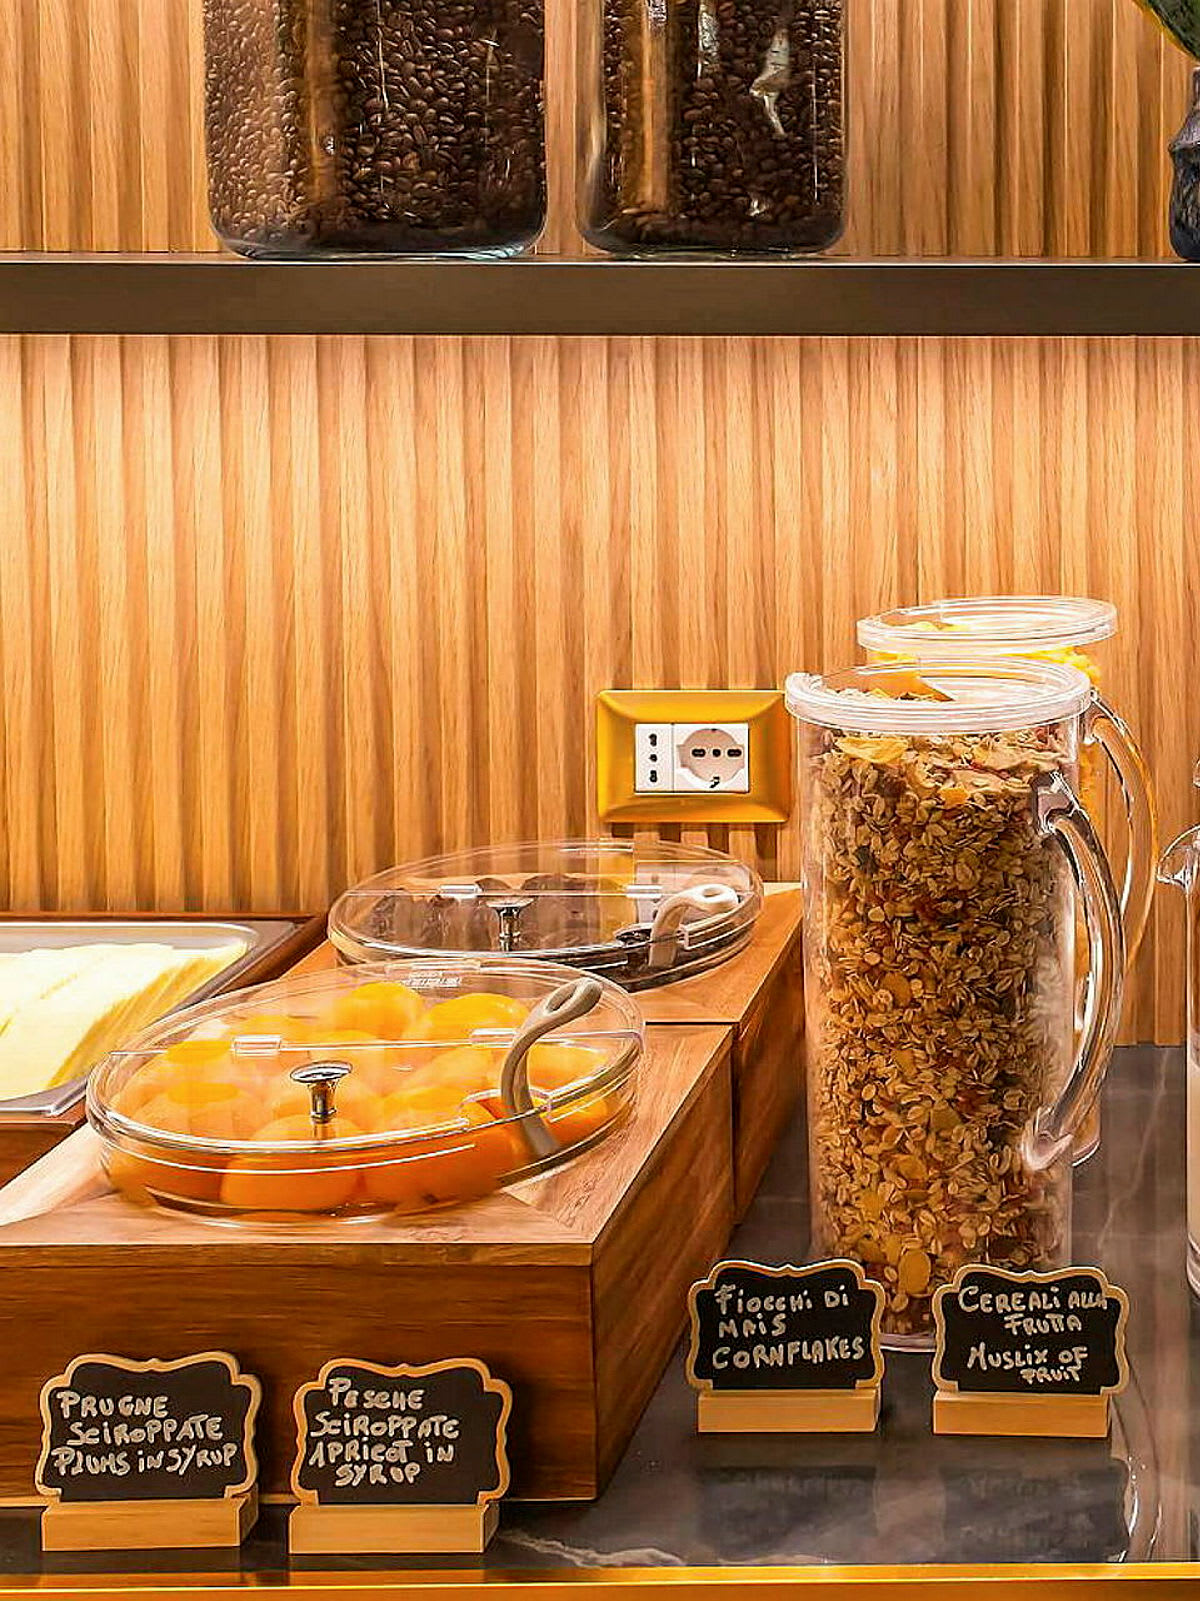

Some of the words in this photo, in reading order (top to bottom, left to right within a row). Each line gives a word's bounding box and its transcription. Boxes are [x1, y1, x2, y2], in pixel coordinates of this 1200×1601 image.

[1004, 1312, 1083, 1335] FRUTTA
[712, 1335, 865, 1369] CORNFLAKES
[1058, 1346, 1089, 1369] OF
[56, 1390, 169, 1418] PRUGNE
[165, 1442, 238, 1475] SYRUP
